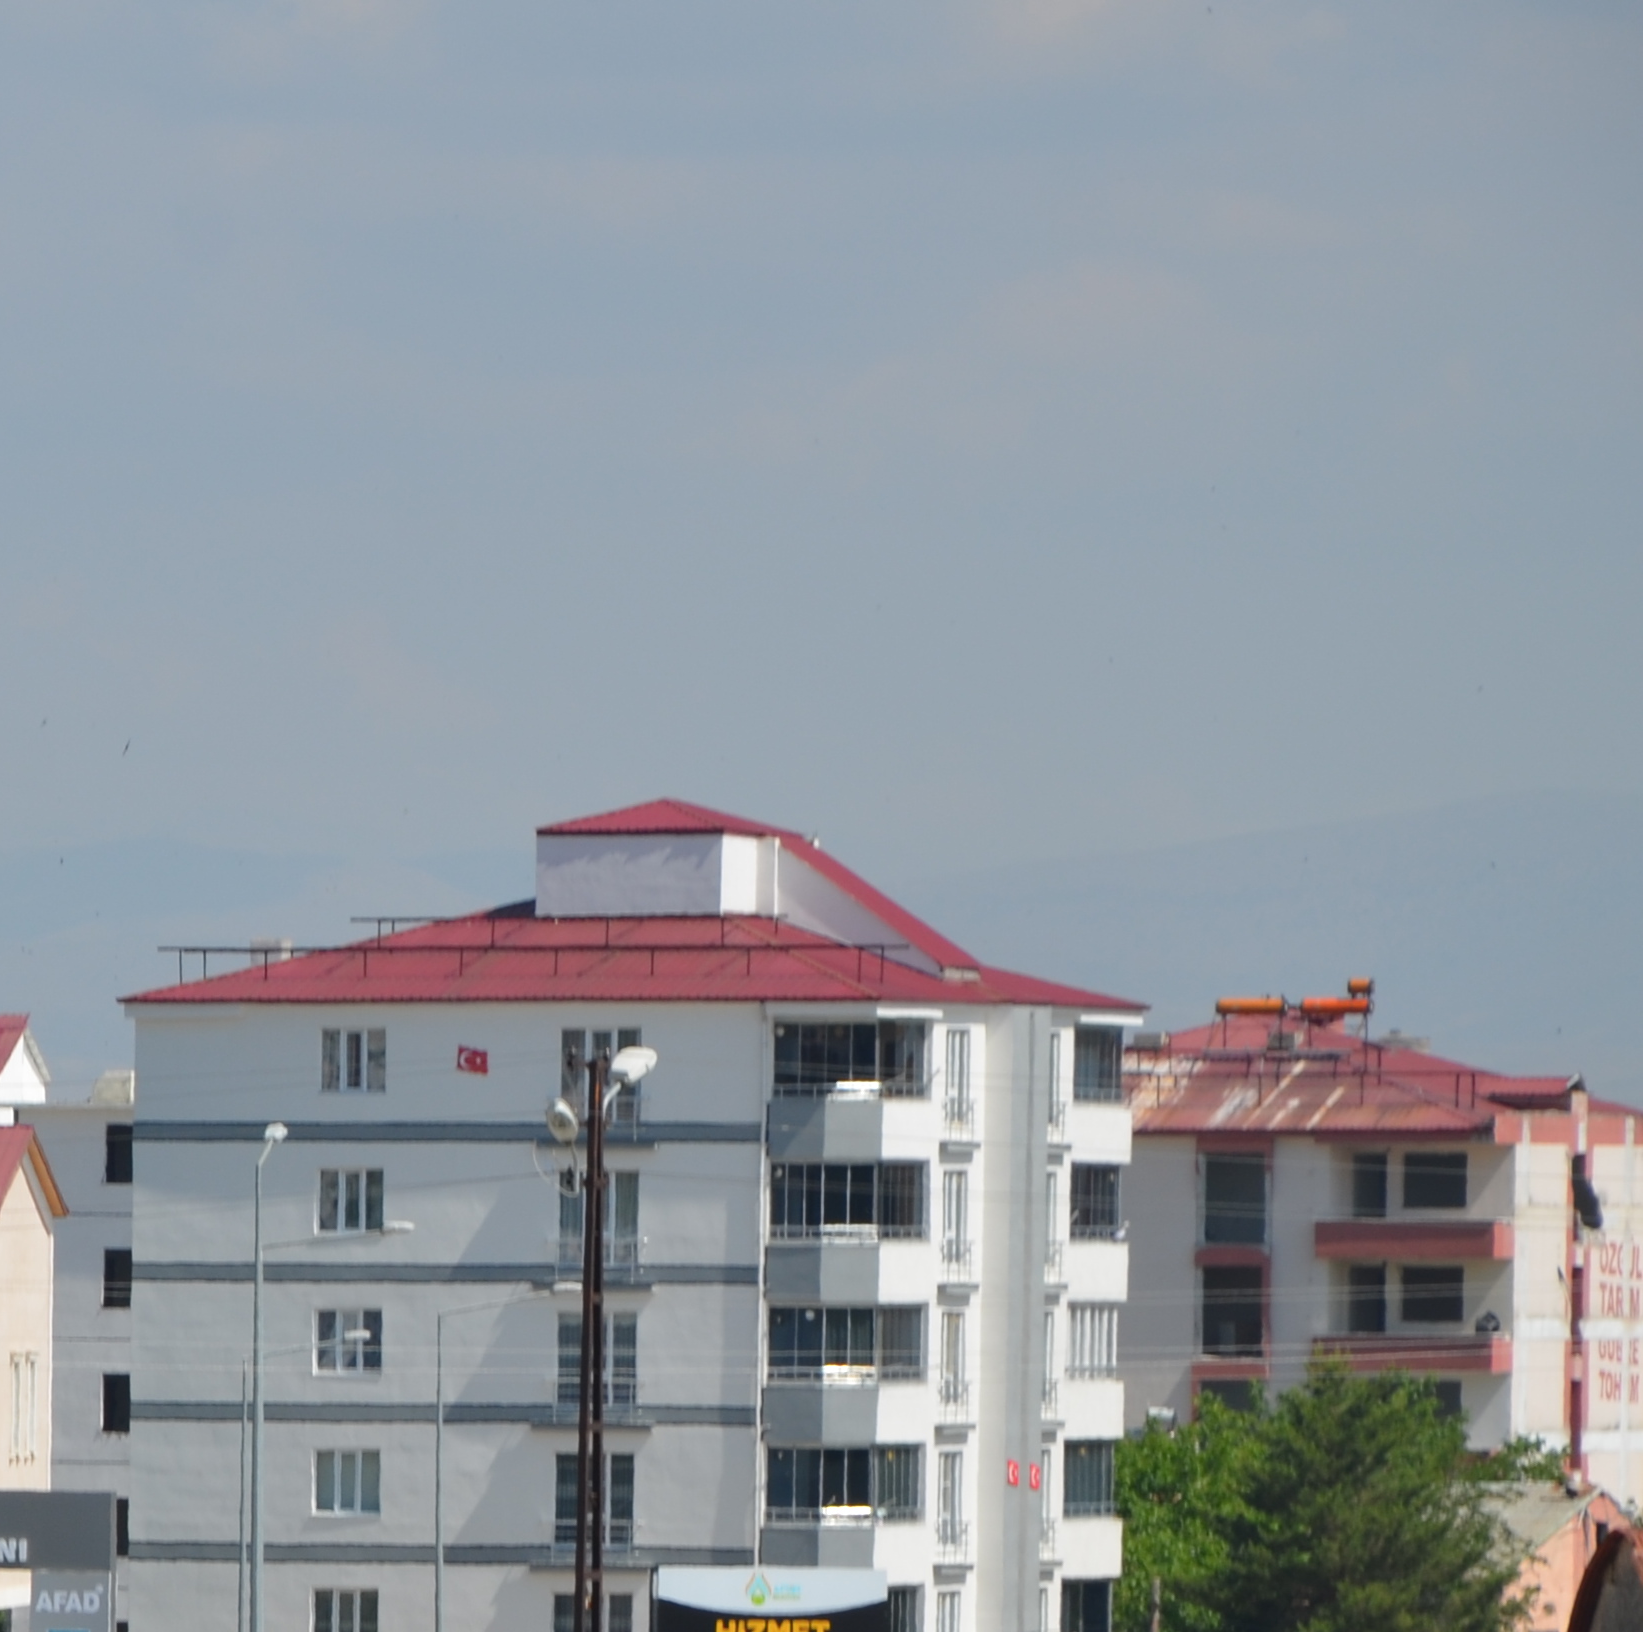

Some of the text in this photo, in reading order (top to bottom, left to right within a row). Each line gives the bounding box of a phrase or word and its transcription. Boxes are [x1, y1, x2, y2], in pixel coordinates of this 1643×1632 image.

[1599, 1282, 1640, 1318] TARM
[1599, 1371, 1639, 1404] TOHM
[35, 1589, 101, 1614] AFAD
